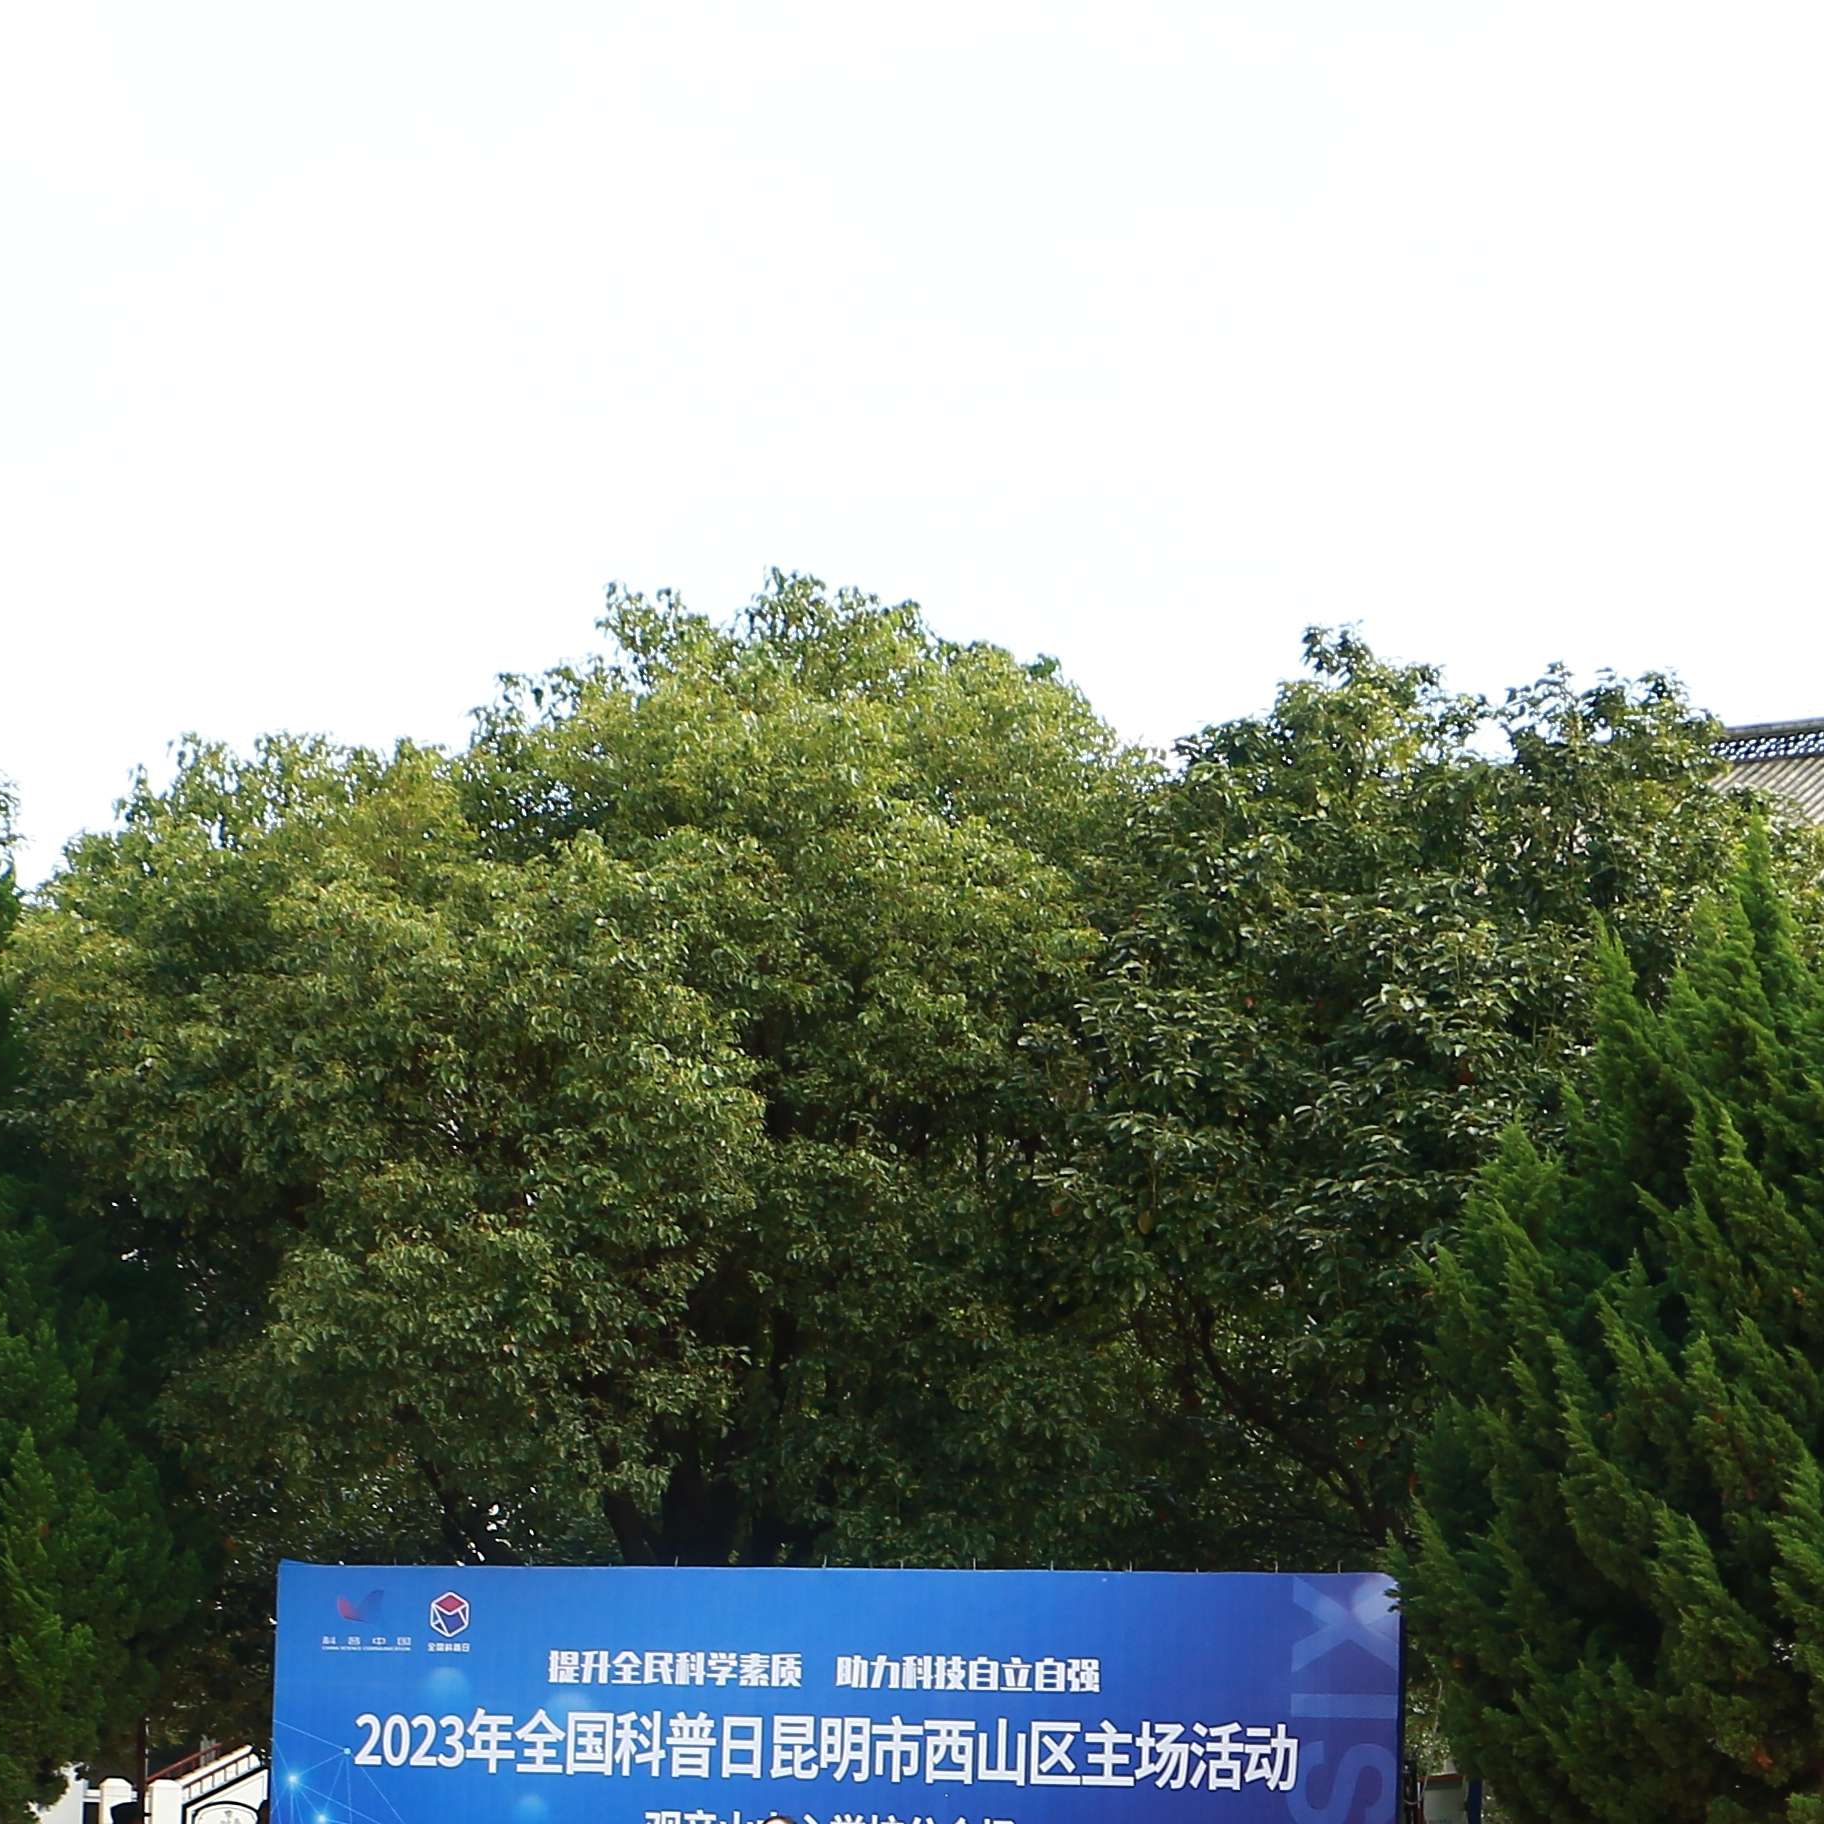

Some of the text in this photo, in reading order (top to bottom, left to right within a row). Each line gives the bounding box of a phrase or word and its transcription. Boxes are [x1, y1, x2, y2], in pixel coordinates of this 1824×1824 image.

[427, 1642, 471, 1652] 全国科普日
[547, 1650, 1101, 1693] 提升全民科学素质 助力科技自立自强
[354, 1707, 1300, 1791] 2023年全国科普日昆明市西山区主场活动
